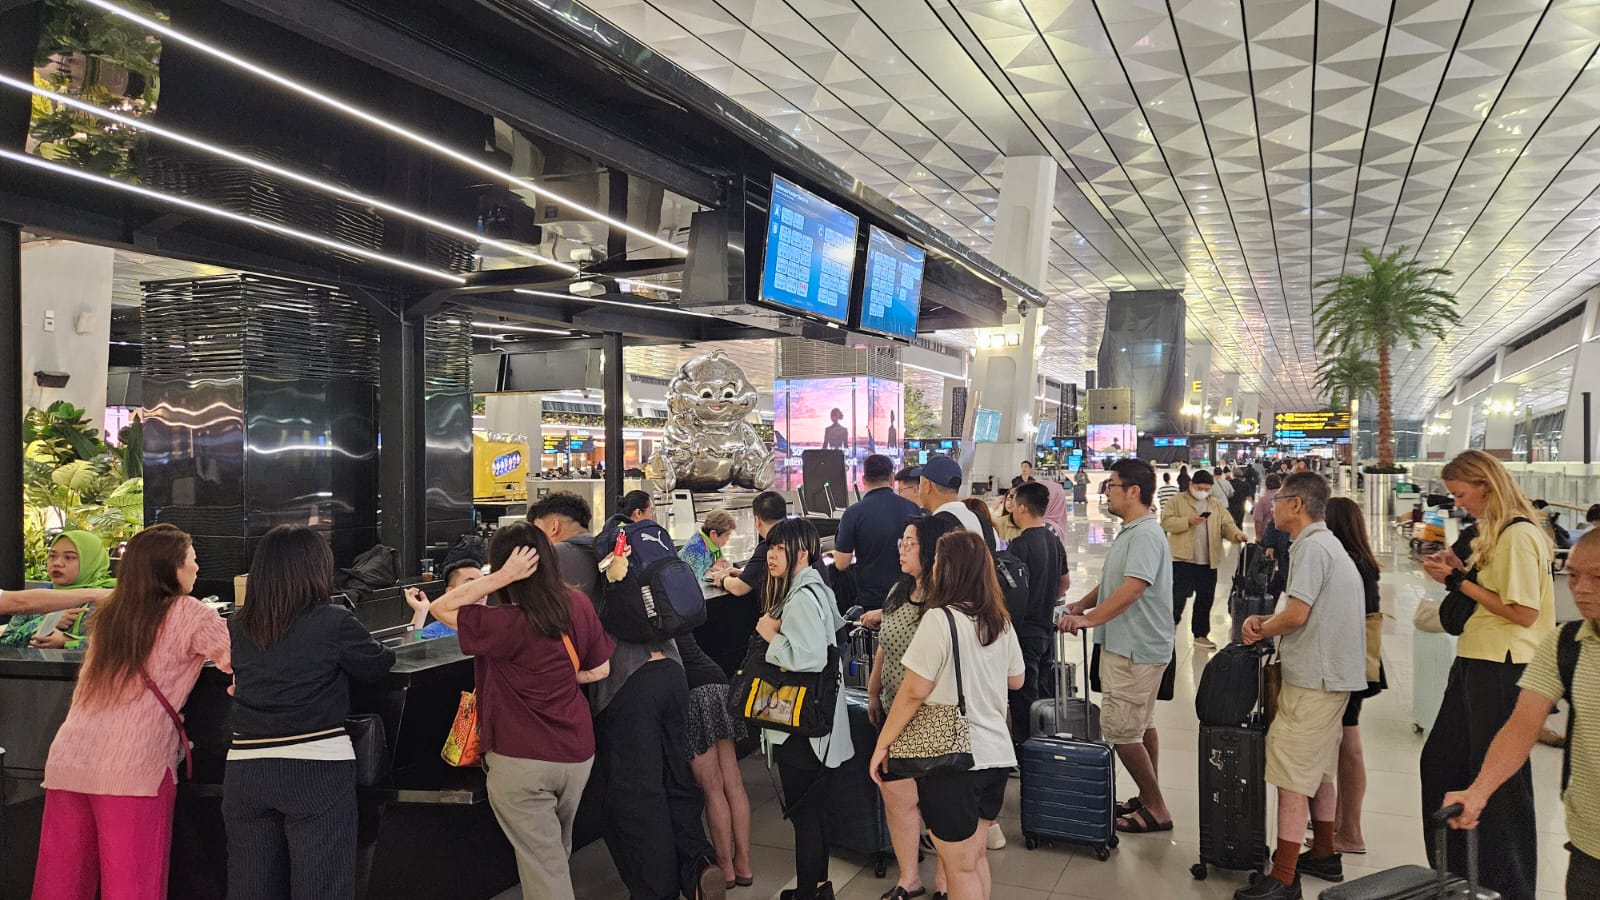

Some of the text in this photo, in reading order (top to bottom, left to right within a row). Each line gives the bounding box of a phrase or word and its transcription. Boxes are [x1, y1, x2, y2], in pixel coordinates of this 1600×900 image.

[1192, 380, 1203, 393] E
[1225, 397, 1233, 407] F
[1243, 418, 1258, 435] D
